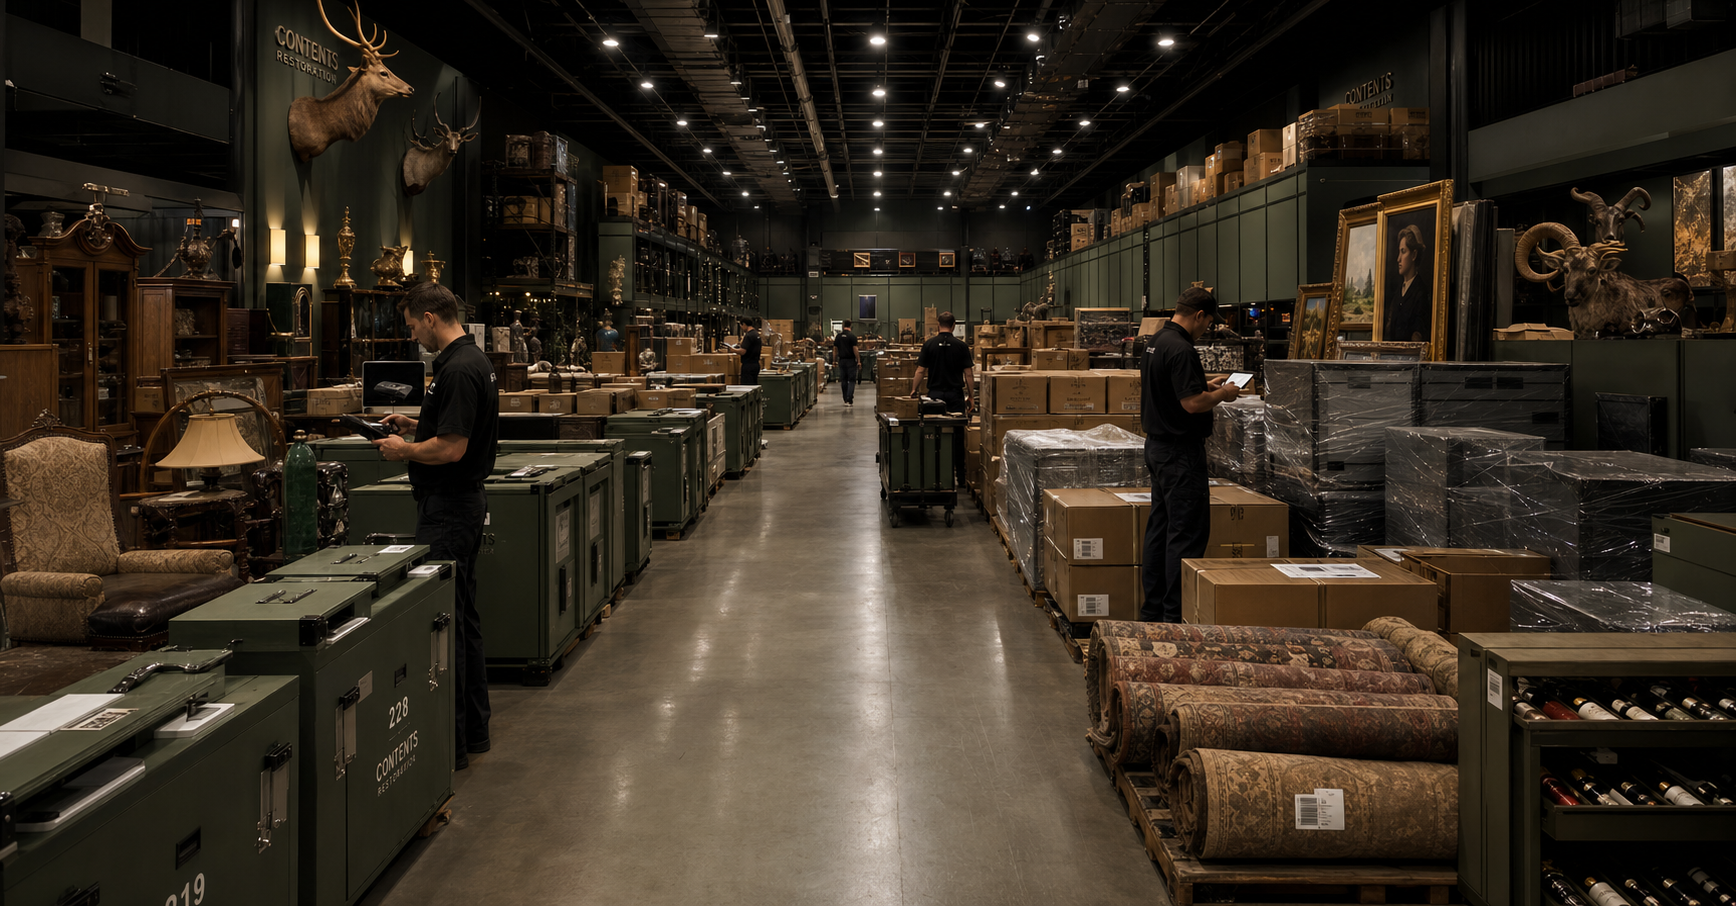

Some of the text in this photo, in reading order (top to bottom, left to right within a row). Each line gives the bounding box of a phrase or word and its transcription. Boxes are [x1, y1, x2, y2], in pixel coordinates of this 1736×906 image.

[275, 25, 339, 71] CONTENTS
[1345, 72, 1393, 105] CONTENTS
[389, 696, 409, 729] 228
[376, 730, 419, 782] CONTENTS
